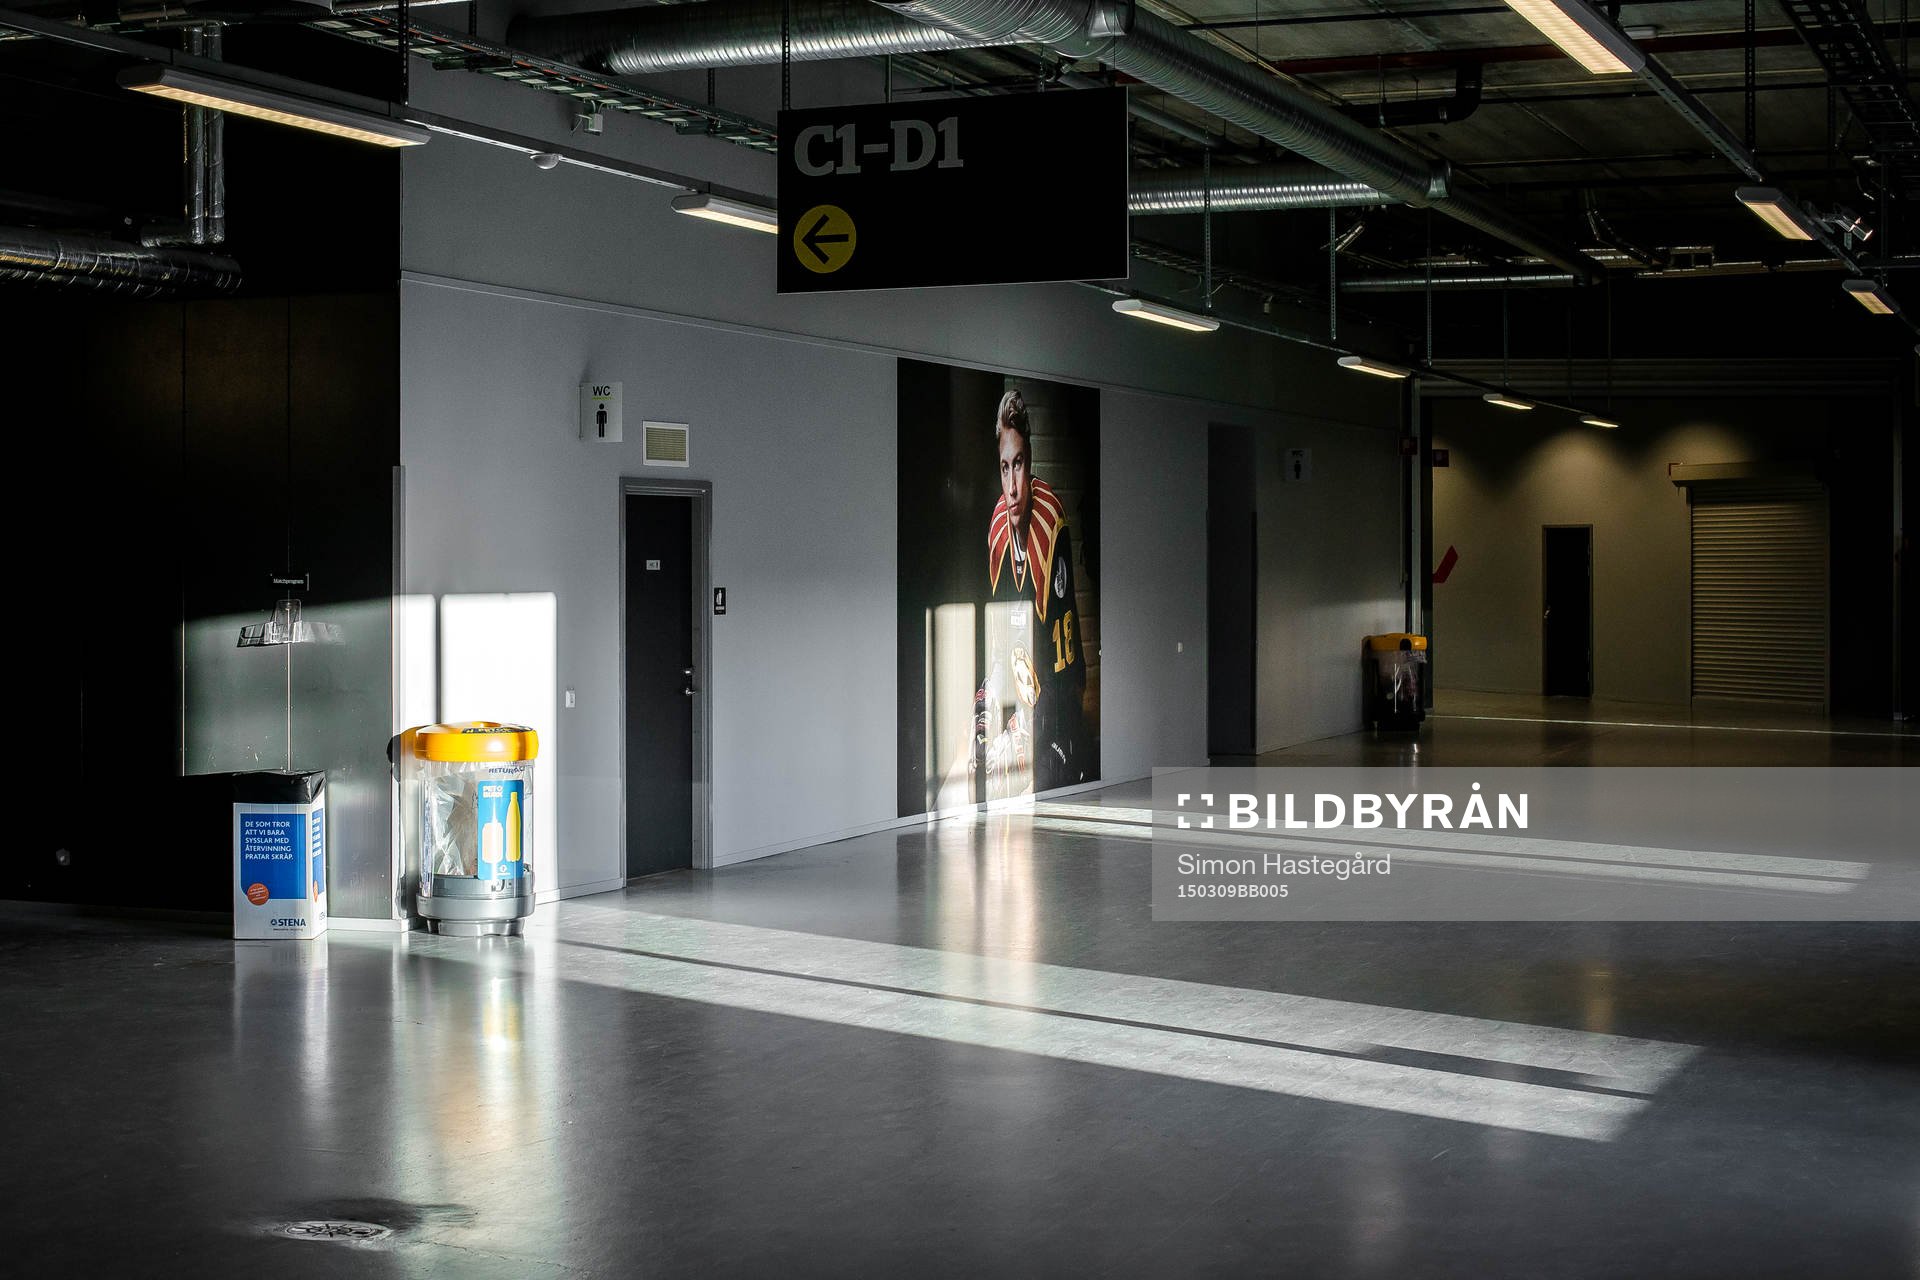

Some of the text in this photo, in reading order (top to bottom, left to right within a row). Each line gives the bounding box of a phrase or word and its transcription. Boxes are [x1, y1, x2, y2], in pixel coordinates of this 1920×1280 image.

[793, 116, 964, 176] C1-D1
[593, 385, 610, 396] WC
[1052, 610, 1075, 672] 18
[245, 844, 292, 852] ÅTERVINNING
[278, 918, 306, 926] STENA
